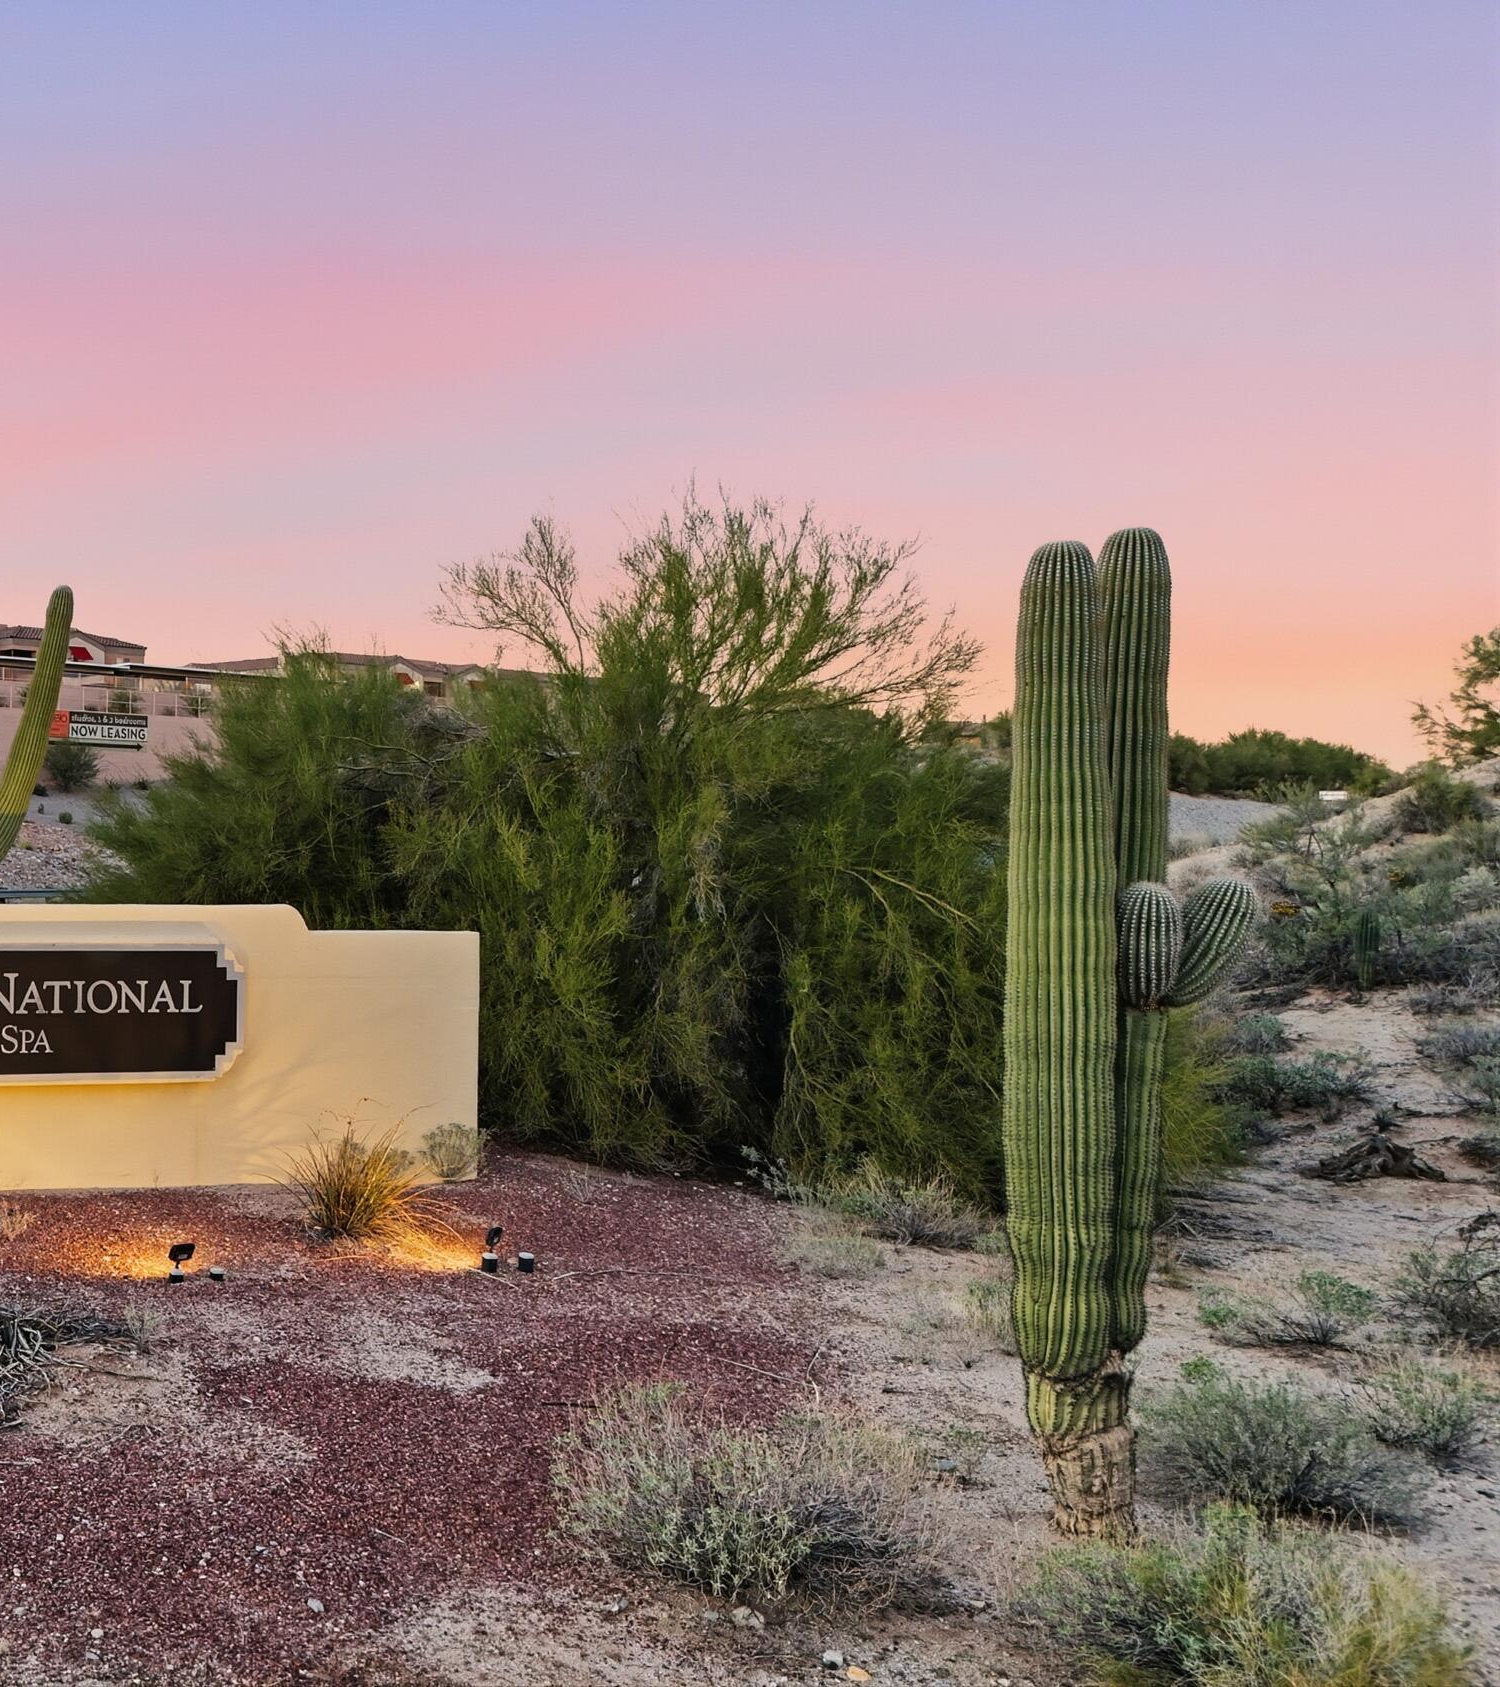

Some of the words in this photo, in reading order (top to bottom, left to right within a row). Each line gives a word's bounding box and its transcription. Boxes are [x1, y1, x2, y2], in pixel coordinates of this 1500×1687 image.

[114, 715, 147, 727] bedrooms
[70, 725, 99, 737] NOW
[101, 727, 146, 740] LEASING
